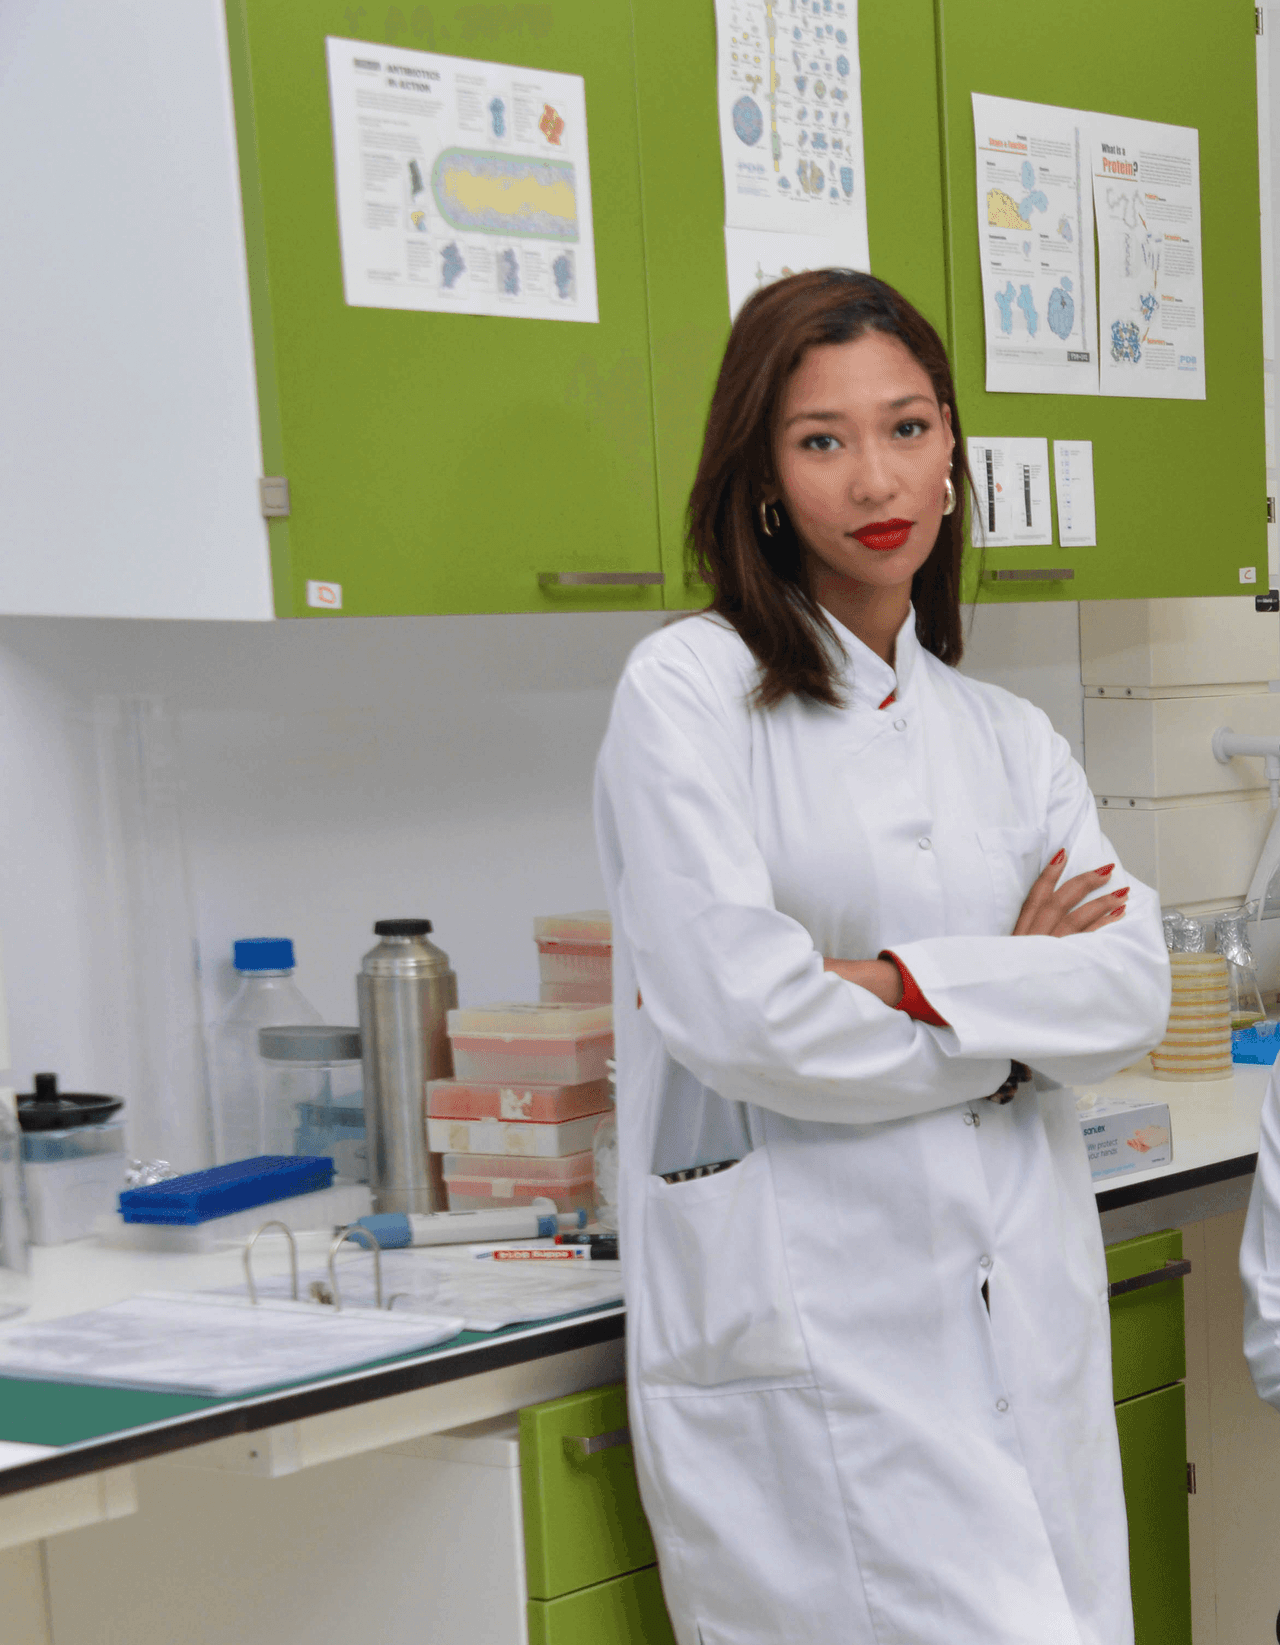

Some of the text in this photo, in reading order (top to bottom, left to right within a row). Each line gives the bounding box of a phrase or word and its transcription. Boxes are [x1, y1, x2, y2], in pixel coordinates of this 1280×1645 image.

[387, 65, 441, 81] ANTIBIOTICS
[399, 80, 431, 93] ACTION
[1101, 143, 1115, 154] What
[1102, 156, 1138, 176] Protein?
